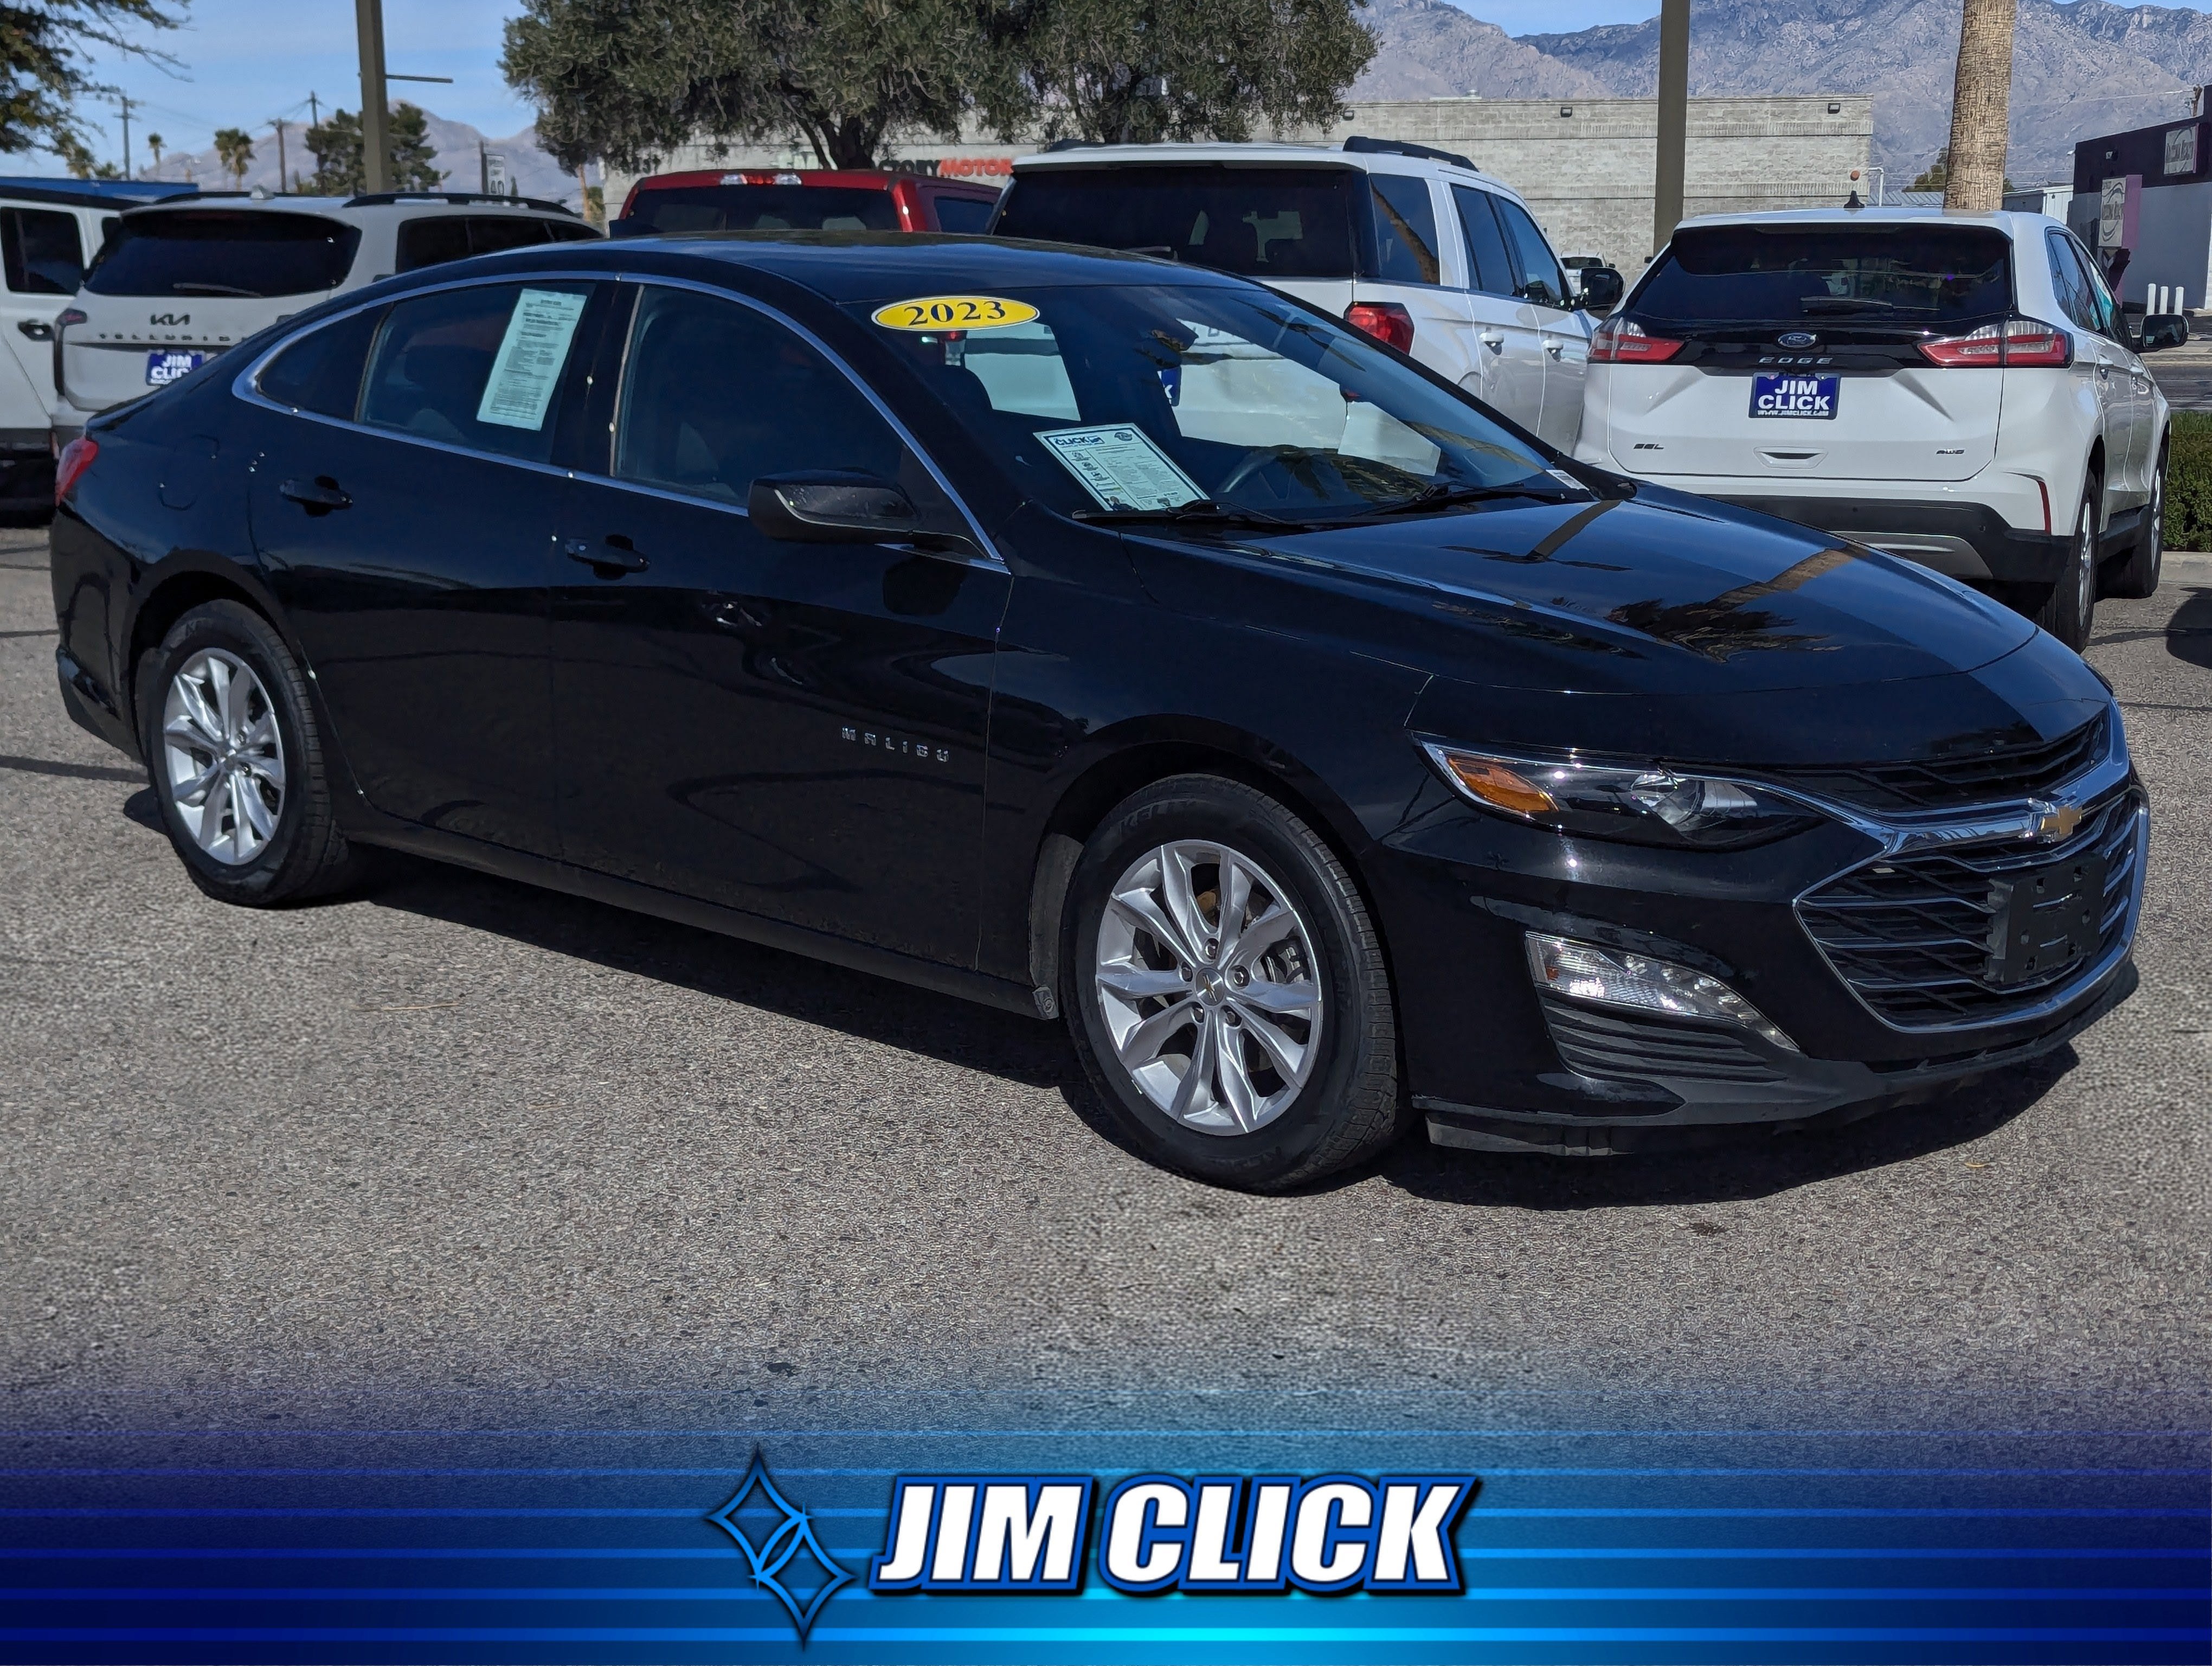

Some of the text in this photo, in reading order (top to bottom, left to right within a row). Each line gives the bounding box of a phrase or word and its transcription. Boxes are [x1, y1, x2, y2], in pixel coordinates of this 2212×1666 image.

[904, 301, 1006, 326] 2023
[162, 354, 192, 370] JIM
[1774, 380, 1818, 395] JIM
[1758, 395, 1830, 410] CLICK
[841, 727, 949, 762] MALIBU
